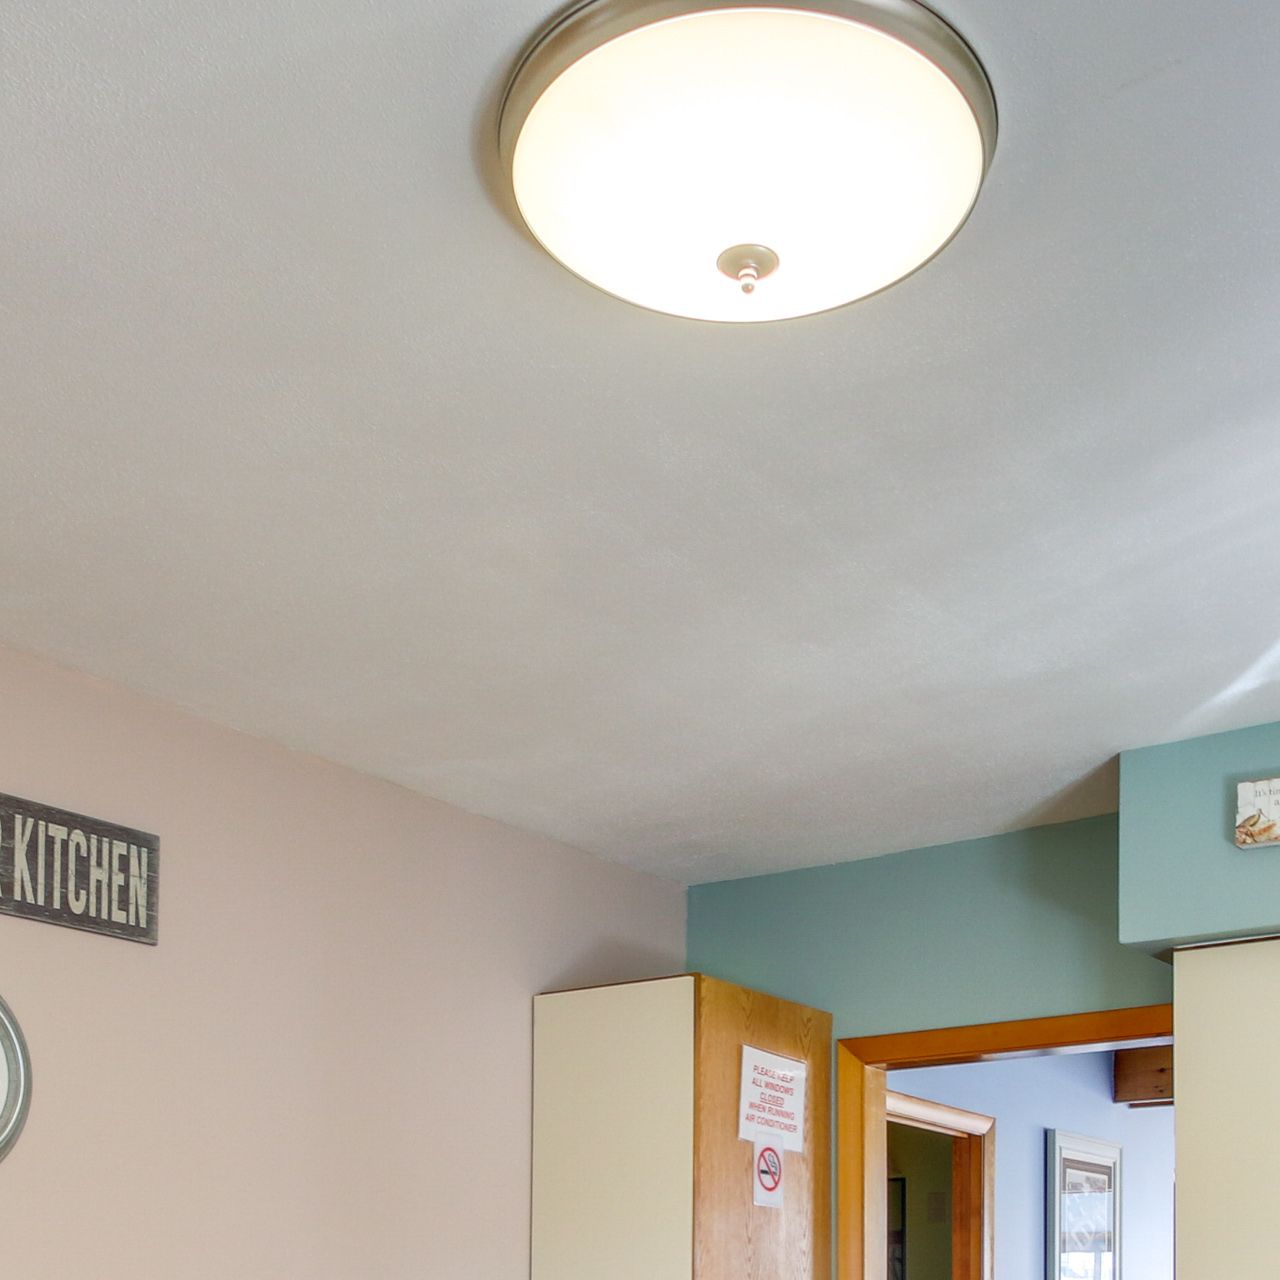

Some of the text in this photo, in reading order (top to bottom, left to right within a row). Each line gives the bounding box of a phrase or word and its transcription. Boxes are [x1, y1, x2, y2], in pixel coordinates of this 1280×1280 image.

[13, 813, 148, 928] KITCHEN
[752, 1077, 794, 1096] ALL WINDOWS
[760, 1092, 785, 1106] CLOSED
[756, 1116, 798, 1133] CONDITIONER
